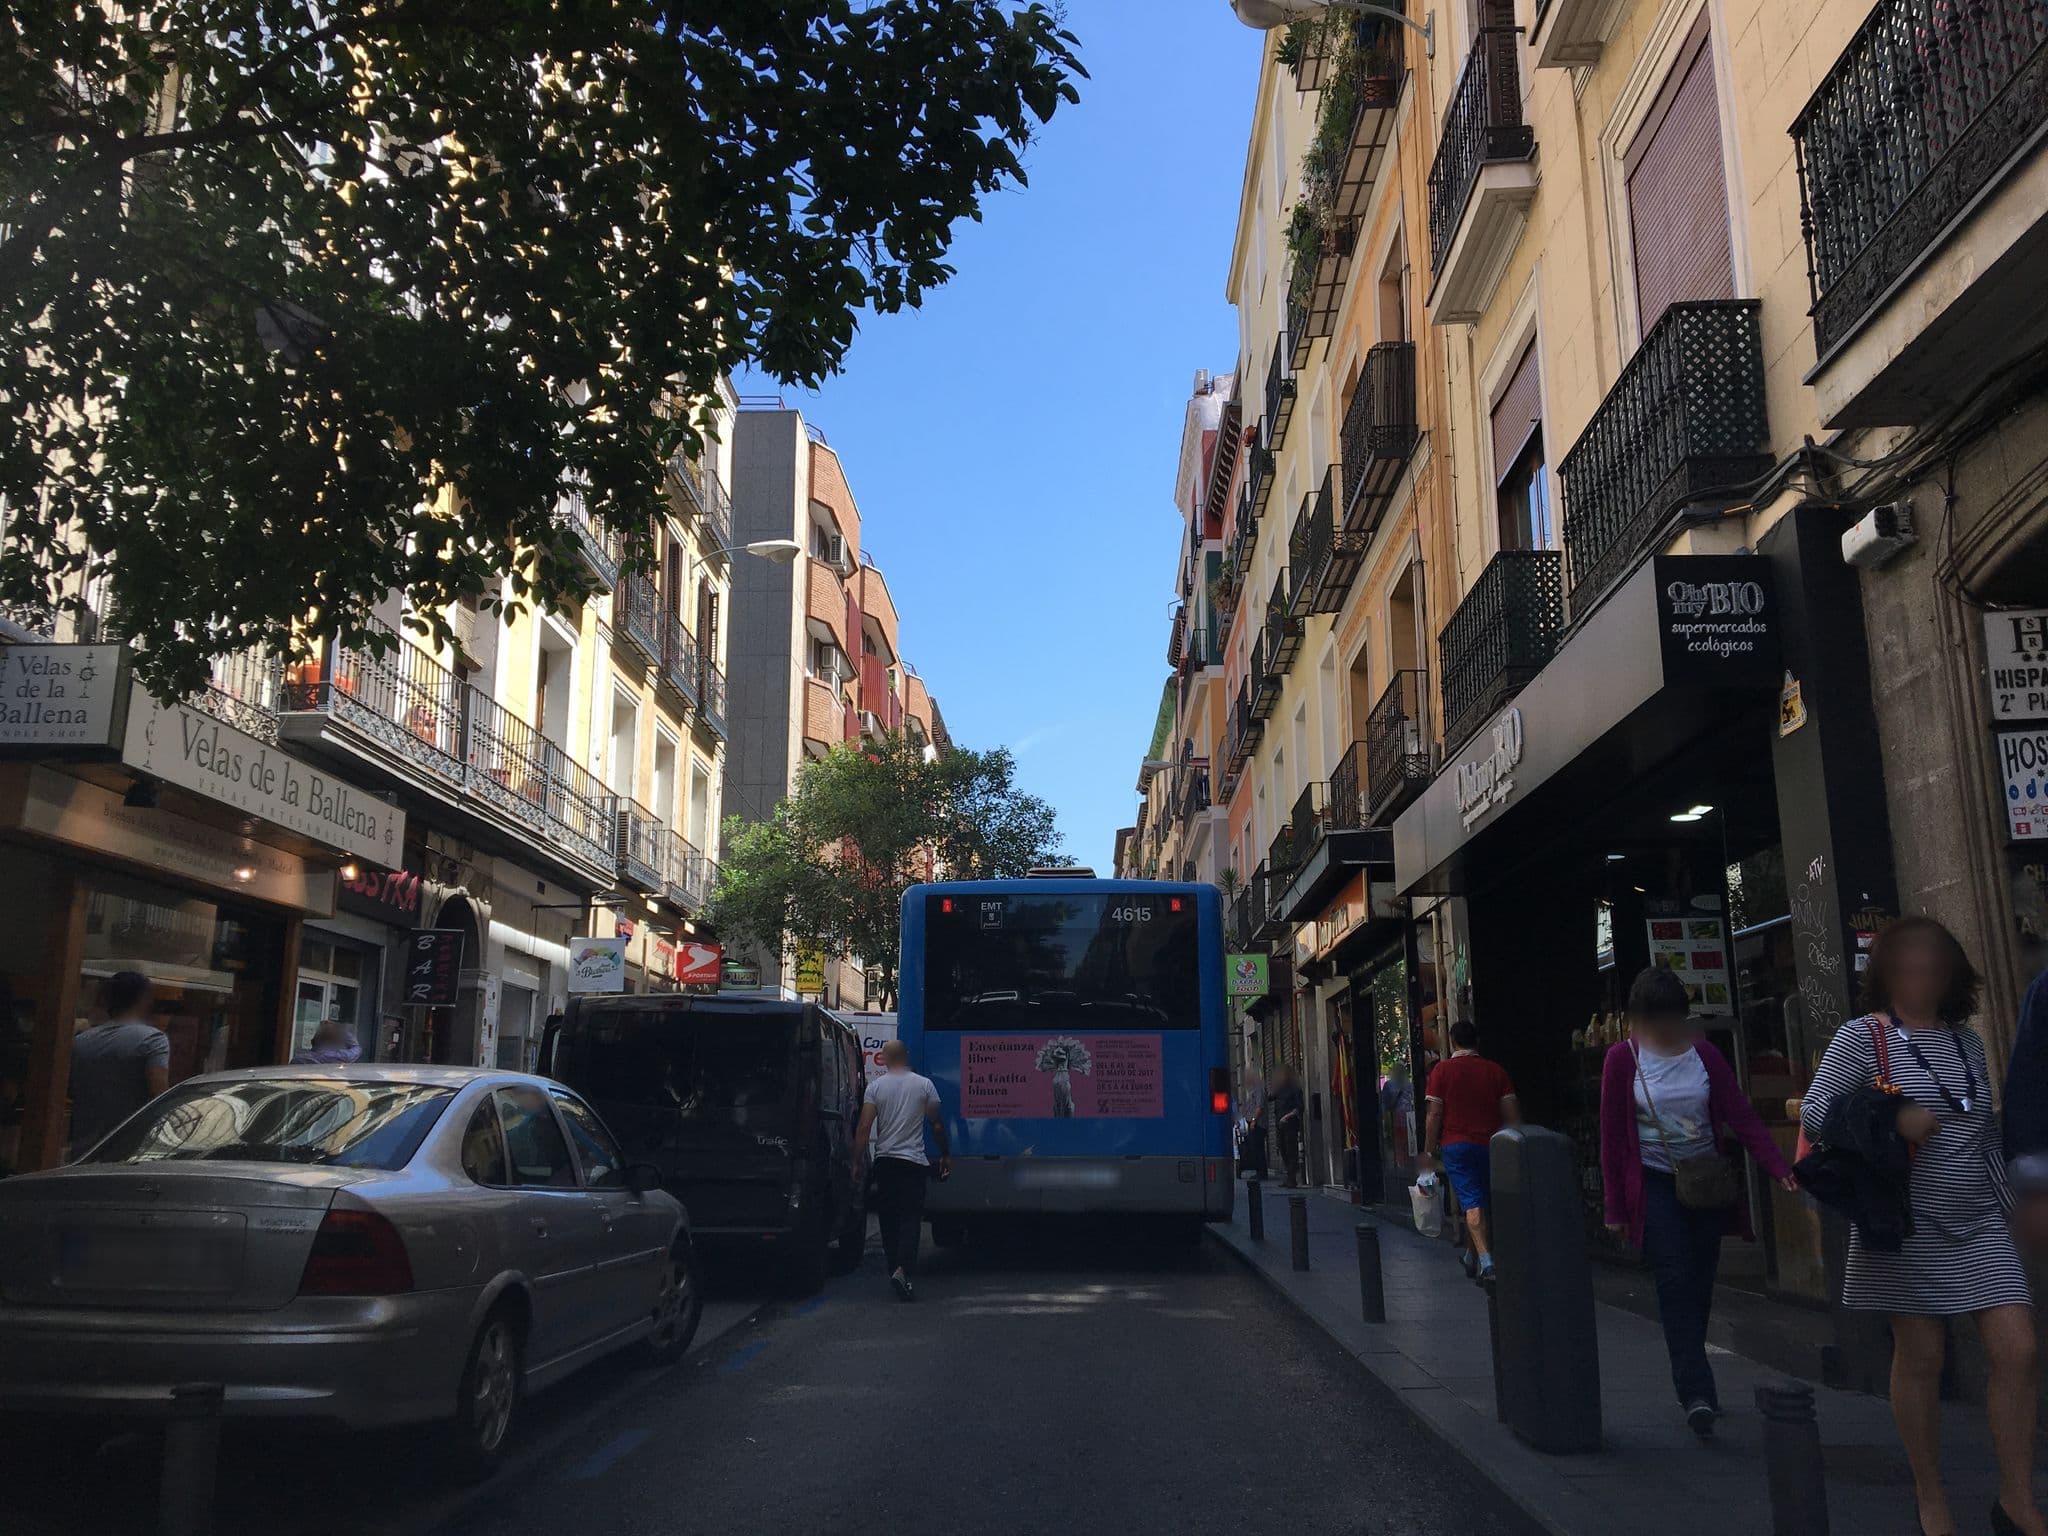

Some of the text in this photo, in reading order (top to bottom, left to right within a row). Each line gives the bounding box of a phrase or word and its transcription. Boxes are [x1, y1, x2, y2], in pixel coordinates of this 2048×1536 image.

[1709, 581, 1765, 615] BIO
[1672, 601, 1706, 619] my
[1671, 617, 1768, 640] supermercados
[1687, 636, 1754, 658] ecológicos
[17, 655, 73, 675] Velas
[16, 679, 65, 698] de la
[2004, 735, 2048, 780] HOS
[179, 711, 377, 840] Velas de la Ballena
[980, 902, 1002, 911] EMT
[1111, 907, 1152, 922] 4615
[411, 934, 436, 1000] BAR
[968, 1041, 1035, 1052] Enseñanza
[968, 1054, 996, 1064] libre
[968, 1073, 1027, 1084] La Gatita
[968, 1086, 1009, 1097] blanca
